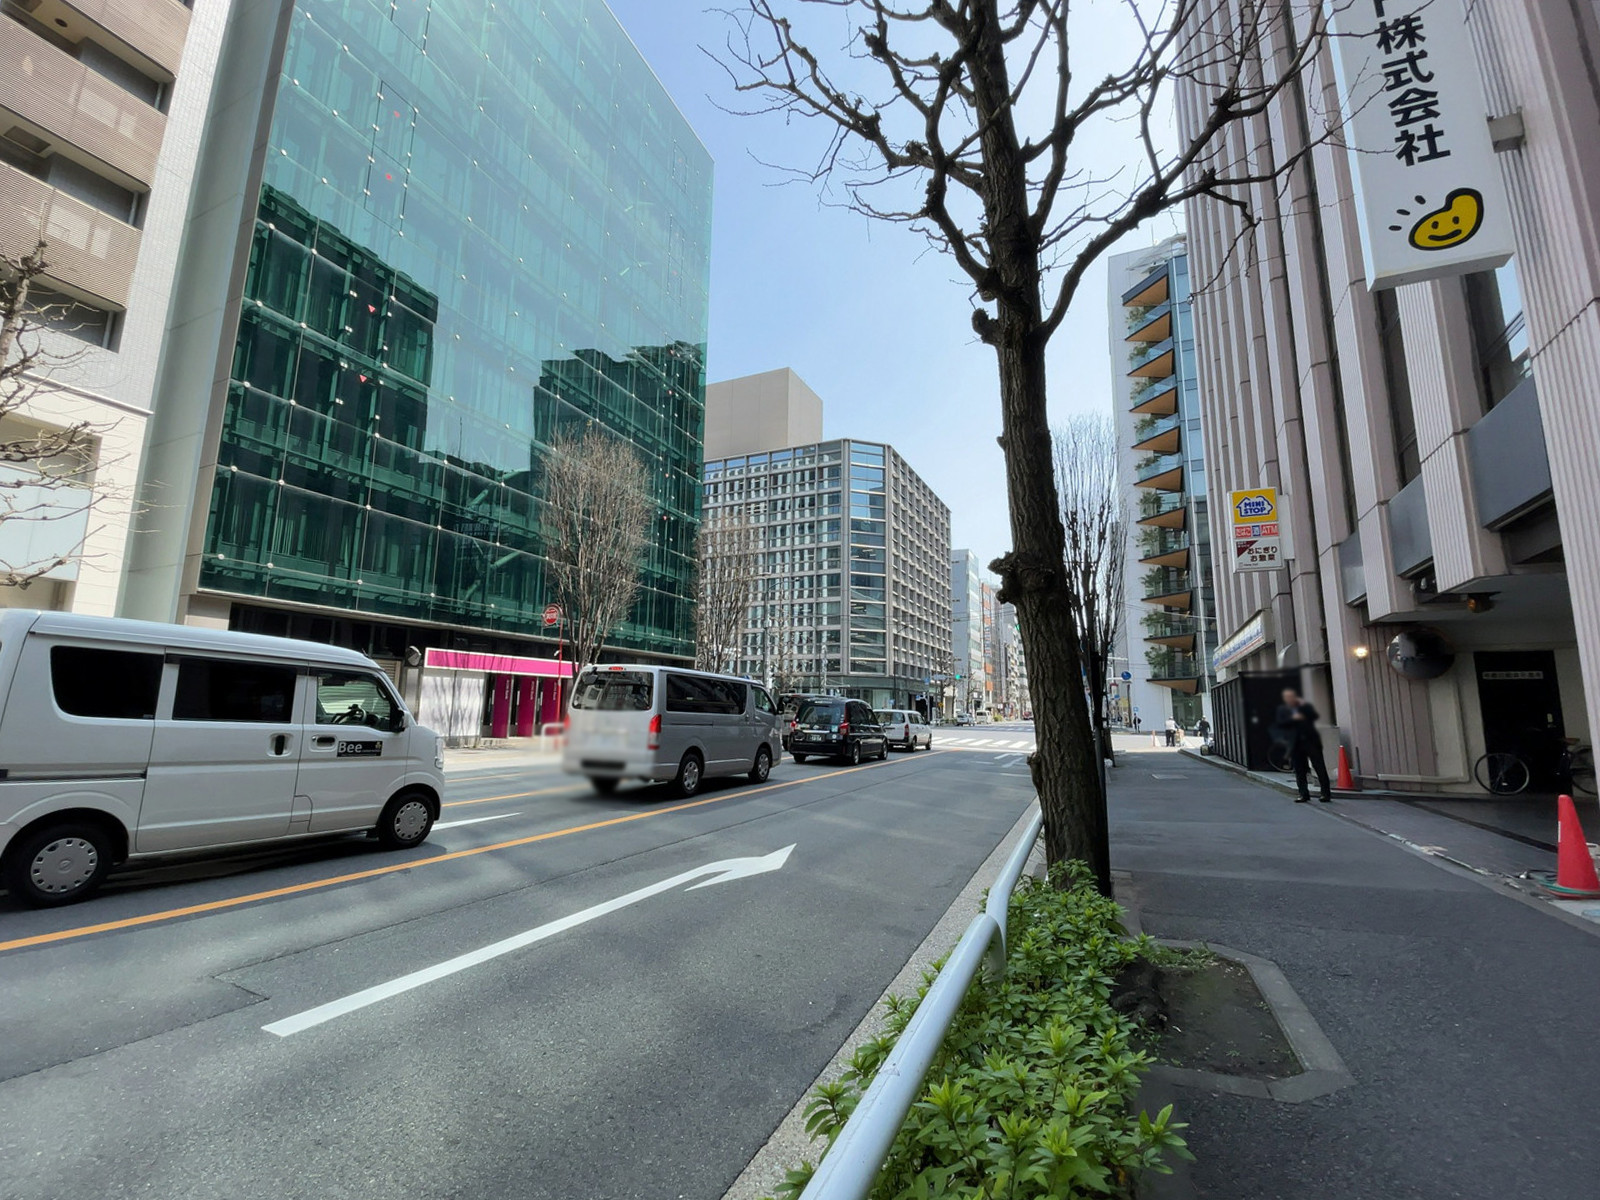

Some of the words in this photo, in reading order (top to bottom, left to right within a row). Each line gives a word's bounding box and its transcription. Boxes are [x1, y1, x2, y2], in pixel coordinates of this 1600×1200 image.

[1262, 525, 1278, 535] ATM
[1247, 546, 1278, 555] おにぎり
[338, 742, 363, 752] Bee
